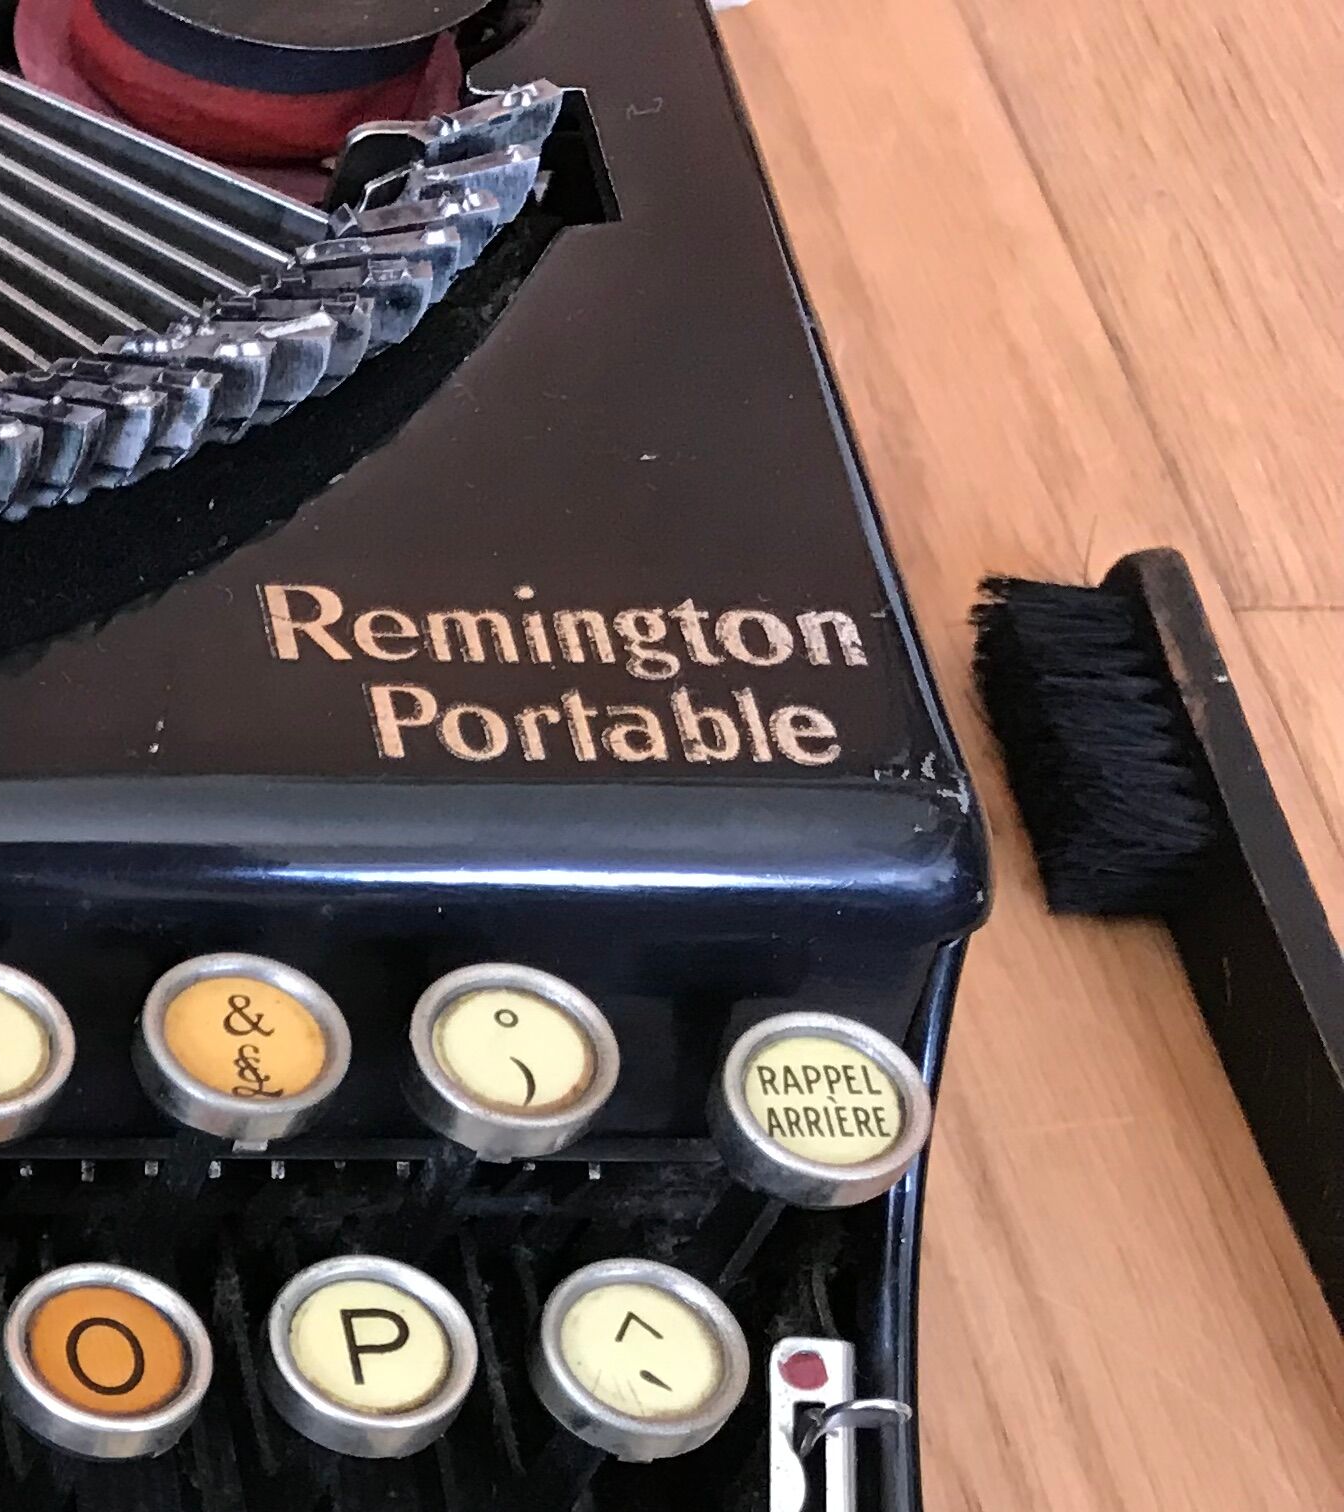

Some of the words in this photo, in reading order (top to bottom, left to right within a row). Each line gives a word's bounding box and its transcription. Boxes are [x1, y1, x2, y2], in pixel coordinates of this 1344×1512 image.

[256, 583, 868, 681] Remington
[364, 684, 842, 767] Portable
[224, 996, 273, 1036] &
[757, 1065, 882, 1095] RAPPEL
[767, 1096, 891, 1138] ARRIÈRE
[66, 1318, 145, 1395] O
[340, 1308, 409, 1384] P
